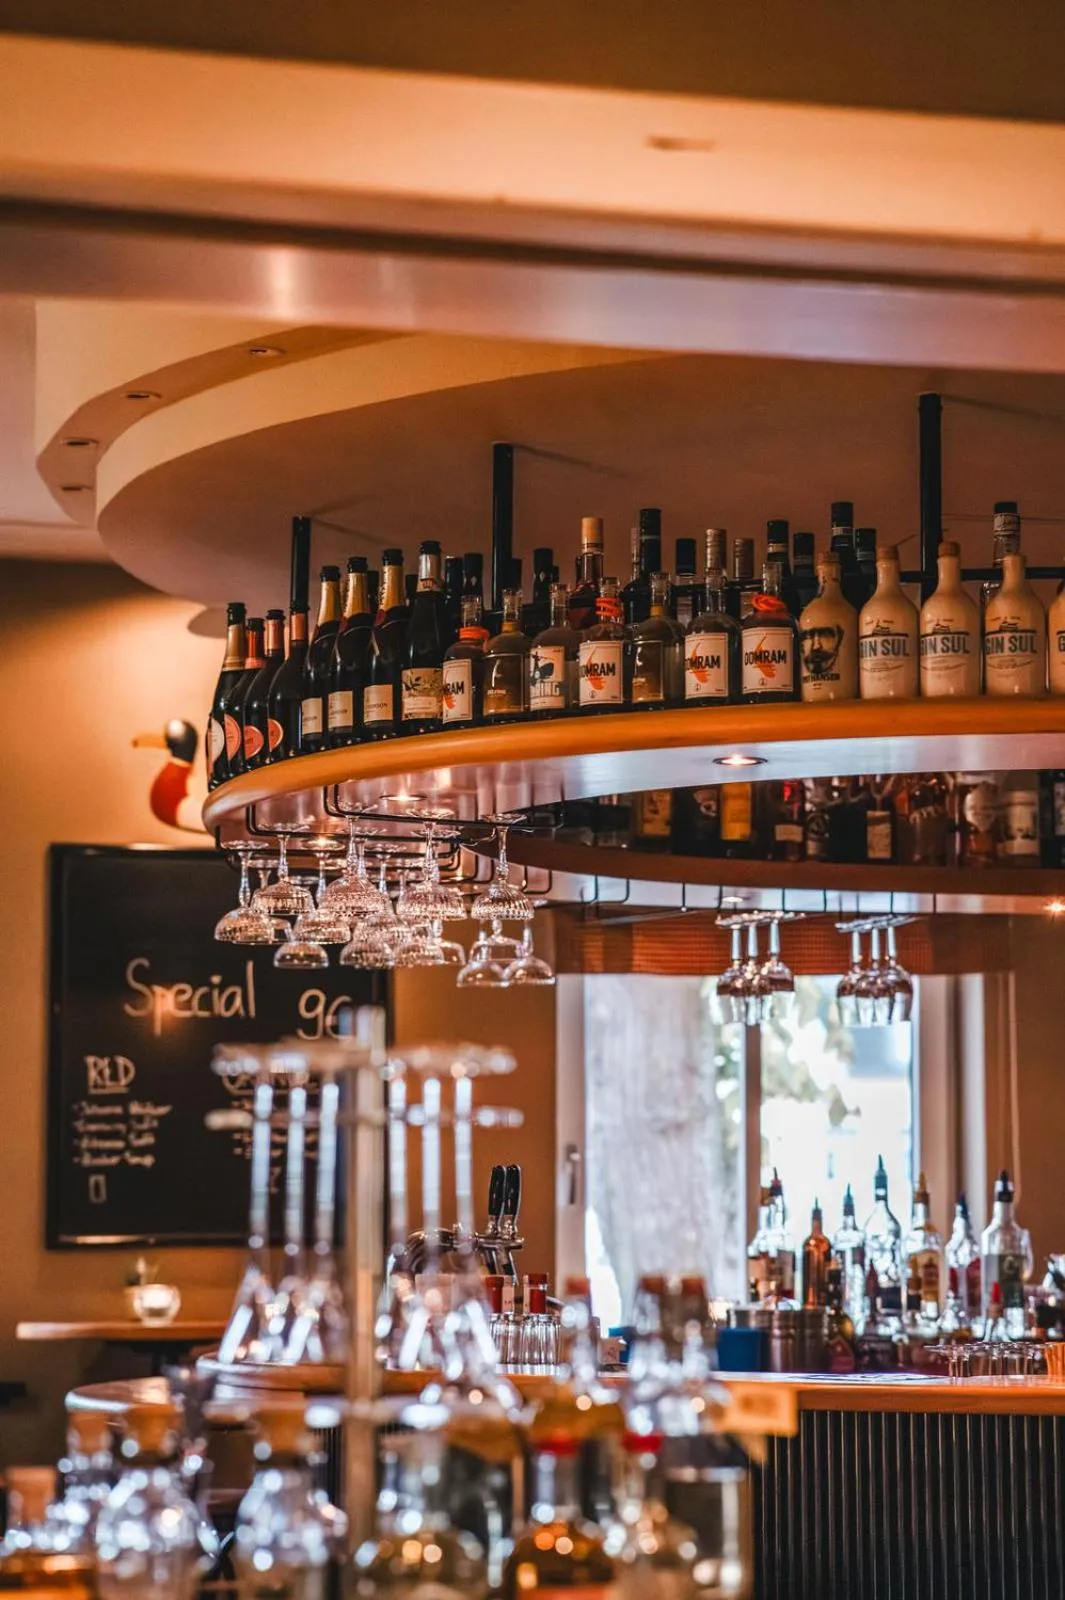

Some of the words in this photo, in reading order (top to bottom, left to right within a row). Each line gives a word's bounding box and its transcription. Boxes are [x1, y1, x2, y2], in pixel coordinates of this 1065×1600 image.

[881, 639, 910, 657] SUL
[941, 636, 970, 653] SUL
[1008, 635, 1037, 653] SUL
[124, 957, 256, 1036] Special
